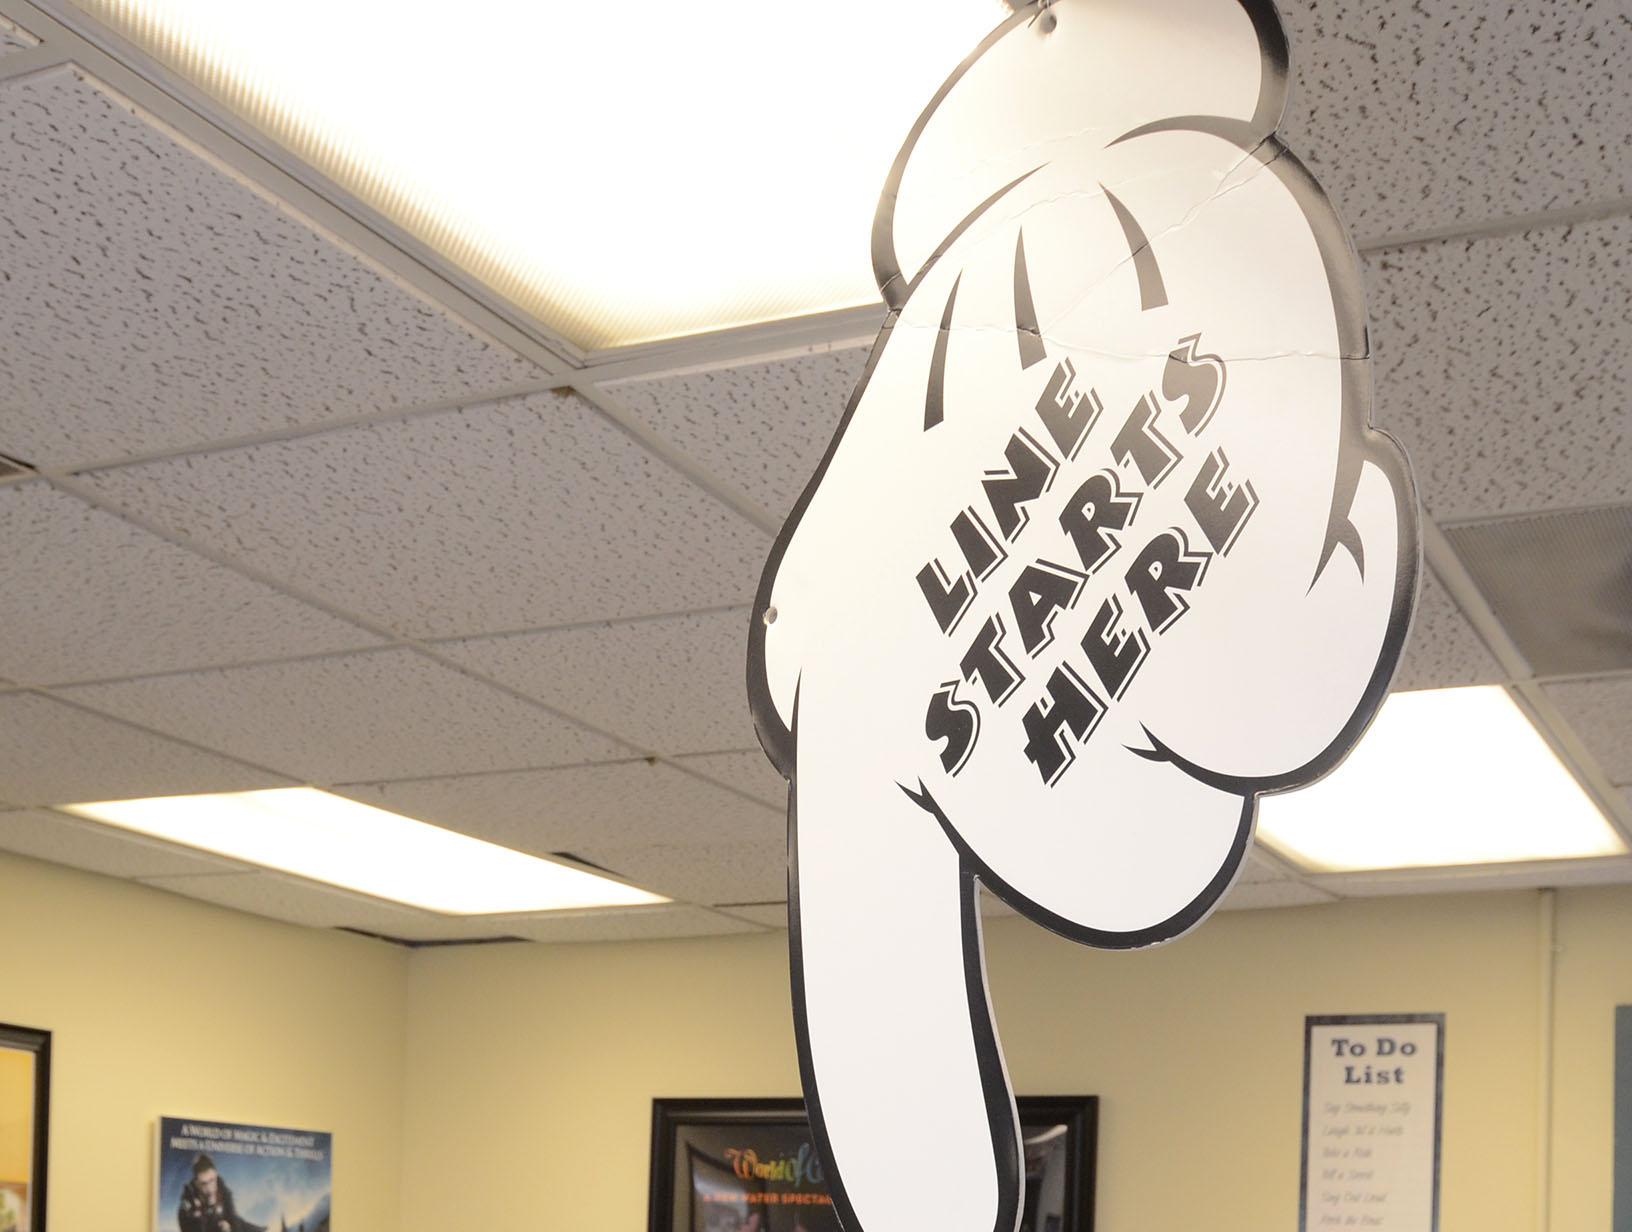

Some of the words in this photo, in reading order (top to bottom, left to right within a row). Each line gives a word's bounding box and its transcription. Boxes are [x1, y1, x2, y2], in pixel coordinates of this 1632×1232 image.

[916, 357, 1104, 637] LINE
[925, 332, 1227, 778] STARTS
[1022, 445, 1260, 788] HERE
[1331, 1038, 1366, 1057] To
[1376, 1038, 1417, 1056] Do
[1344, 1066, 1405, 1084] List
